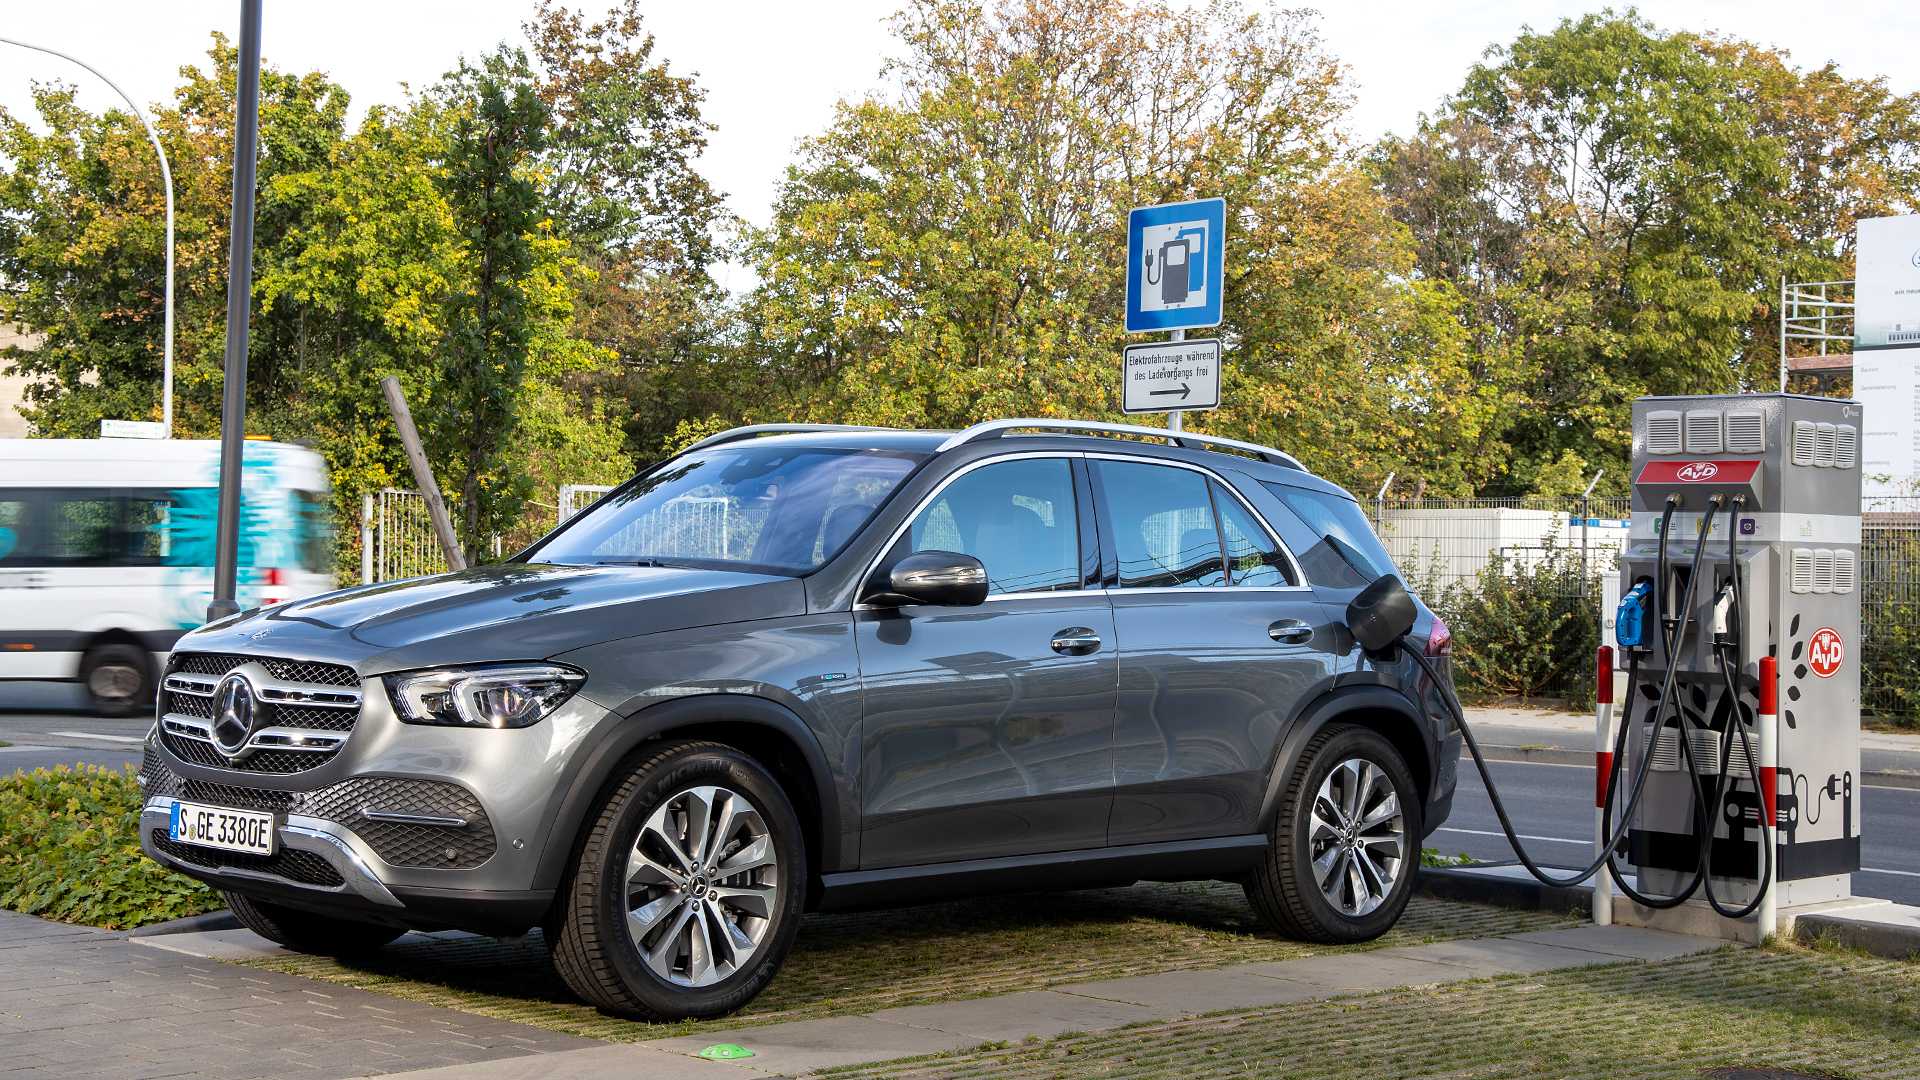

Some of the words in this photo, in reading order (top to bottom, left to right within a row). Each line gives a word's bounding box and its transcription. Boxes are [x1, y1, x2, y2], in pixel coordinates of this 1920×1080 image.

[1129, 352, 1182, 366] Elektrofahrzeuge
[1186, 350, 1214, 361] während
[1134, 370, 1146, 381] des
[1148, 368, 1193, 381] Ladevorgangs
[1196, 365, 1208, 376] frei
[180, 808, 187, 836] S
[197, 811, 215, 841] GE
[218, 815, 269, 848] 3380E
